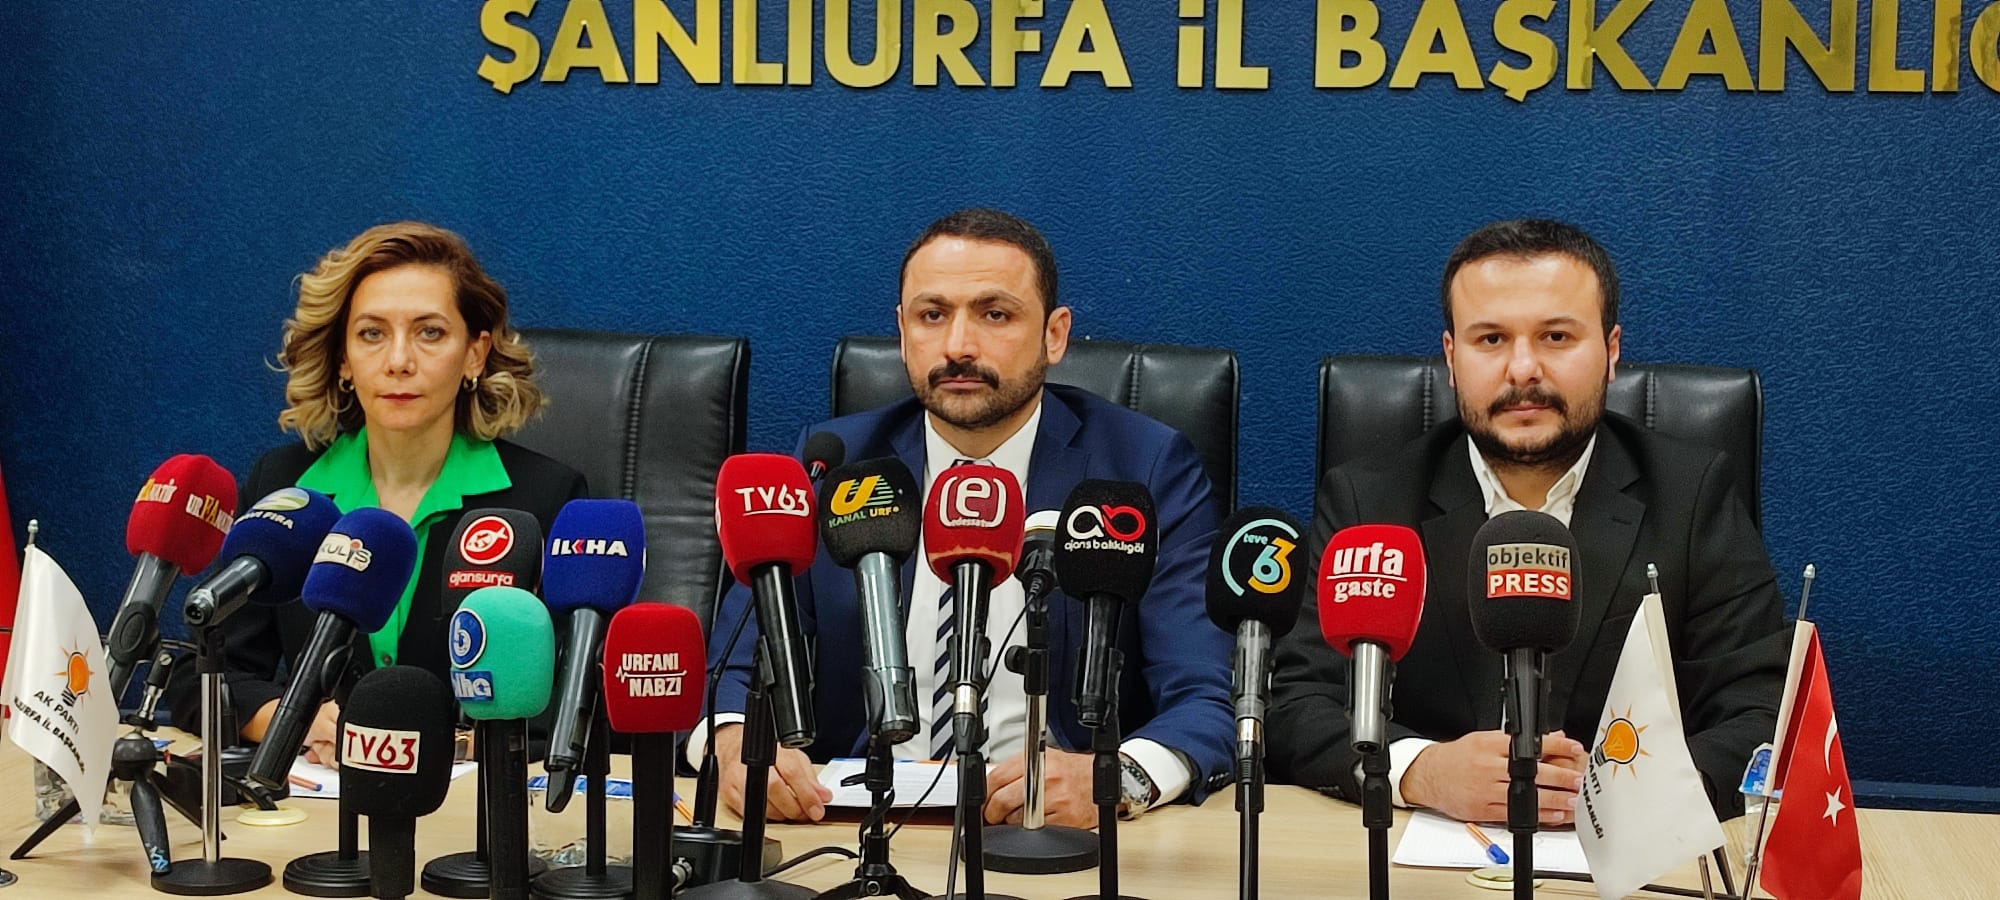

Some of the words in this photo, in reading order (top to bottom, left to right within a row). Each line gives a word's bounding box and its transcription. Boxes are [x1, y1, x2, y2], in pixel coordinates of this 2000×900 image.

[478, 0, 1131, 94] ŞANLIURFA
[734, 483, 810, 516] TV63
[829, 511, 866, 528] KANAL
[1064, 540, 1091, 552] ajans
[1243, 533, 1268, 545] teve
[1248, 537, 1296, 593] 63
[1333, 542, 1404, 576] urfa
[1488, 547, 1568, 569] objektif
[449, 572, 513, 586] ajansurfa
[1490, 573, 1568, 595] PRESS
[1334, 578, 1396, 603] gaste
[622, 653, 679, 671] URFANI
[629, 677, 682, 697] NABZI
[33, 690, 54, 707] AK
[346, 729, 417, 770] TV63
[1583, 775, 1604, 839] AŞKANLIĞI
